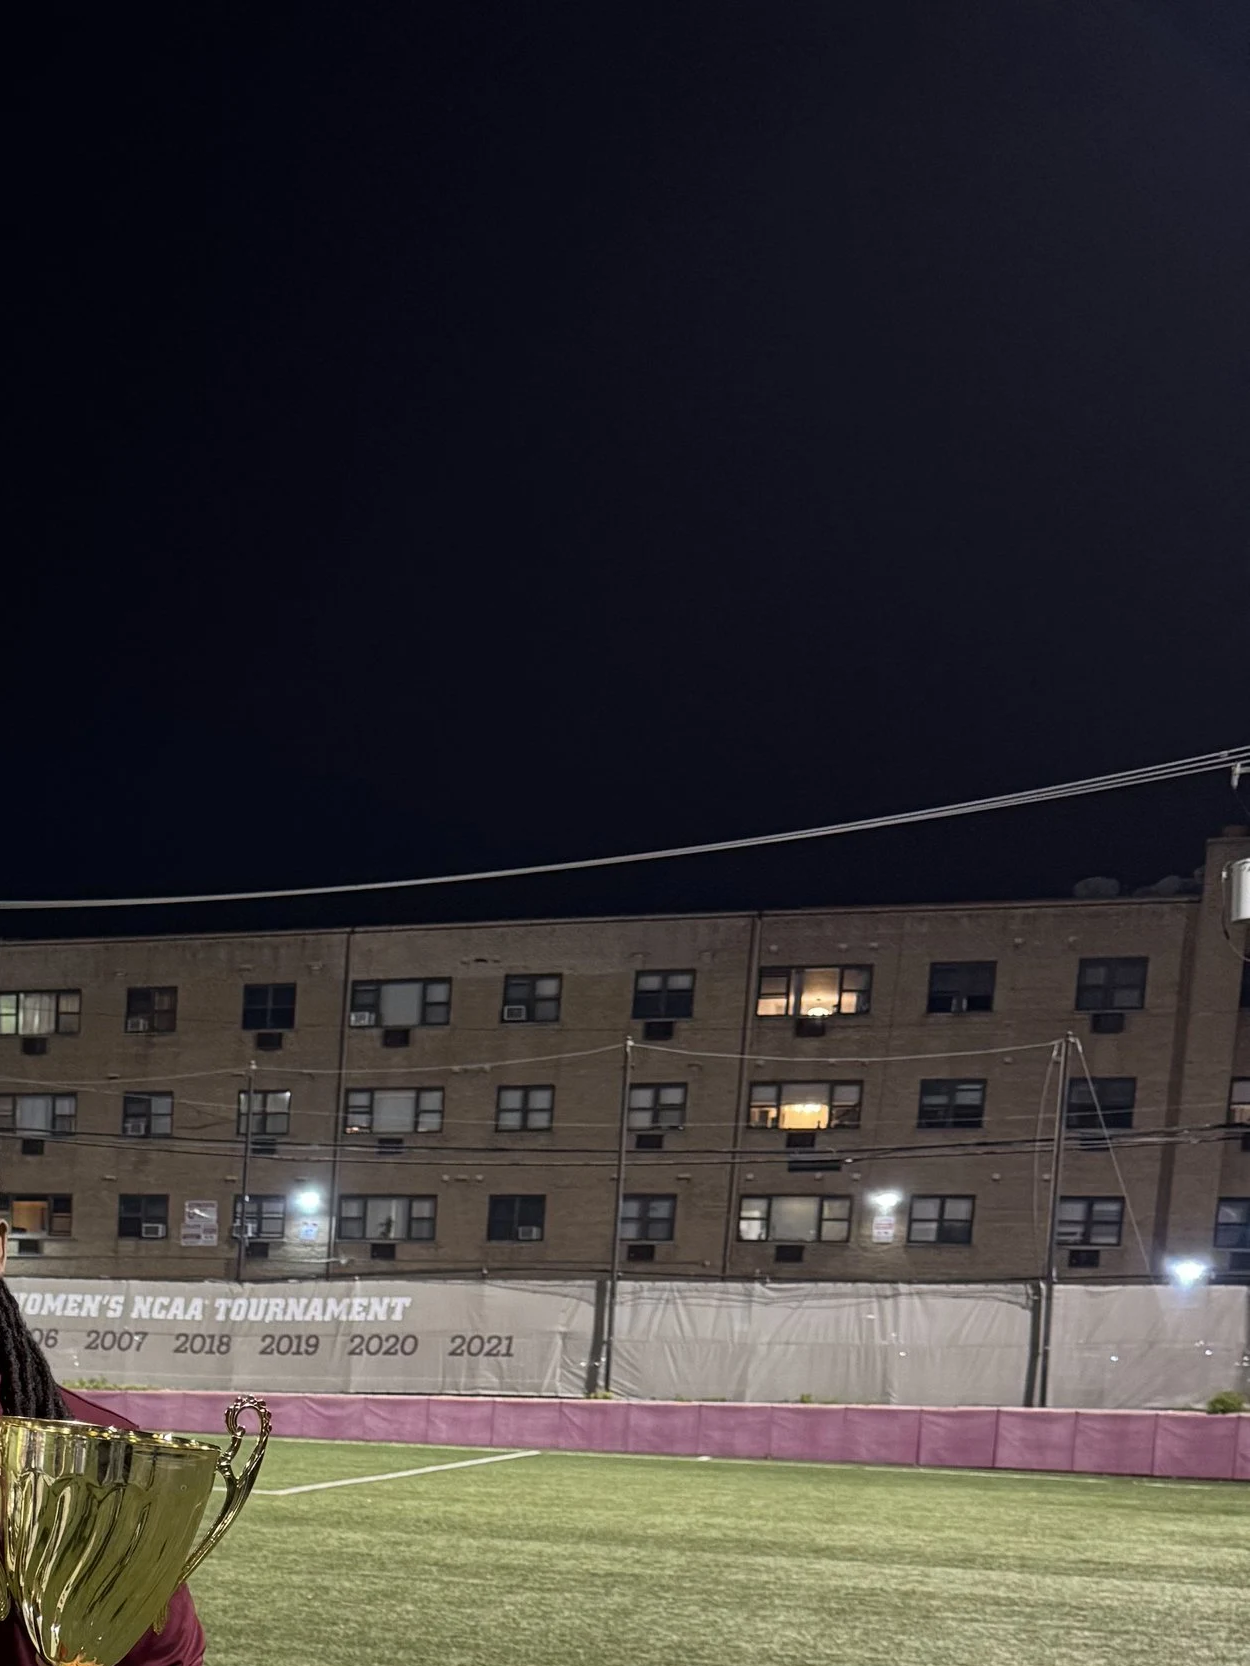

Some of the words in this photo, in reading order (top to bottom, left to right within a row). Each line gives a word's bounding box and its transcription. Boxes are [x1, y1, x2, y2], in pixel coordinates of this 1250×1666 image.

[131, 1296, 204, 1321] NCAA
[214, 1297, 411, 1323] TOURNAMENT
[32, 1328, 59, 1349] 06
[84, 1330, 148, 1352] 2007
[174, 1333, 232, 1355] 2018
[259, 1334, 320, 1356] 2019
[347, 1334, 418, 1356] 2020
[448, 1335, 514, 1358] 2021
